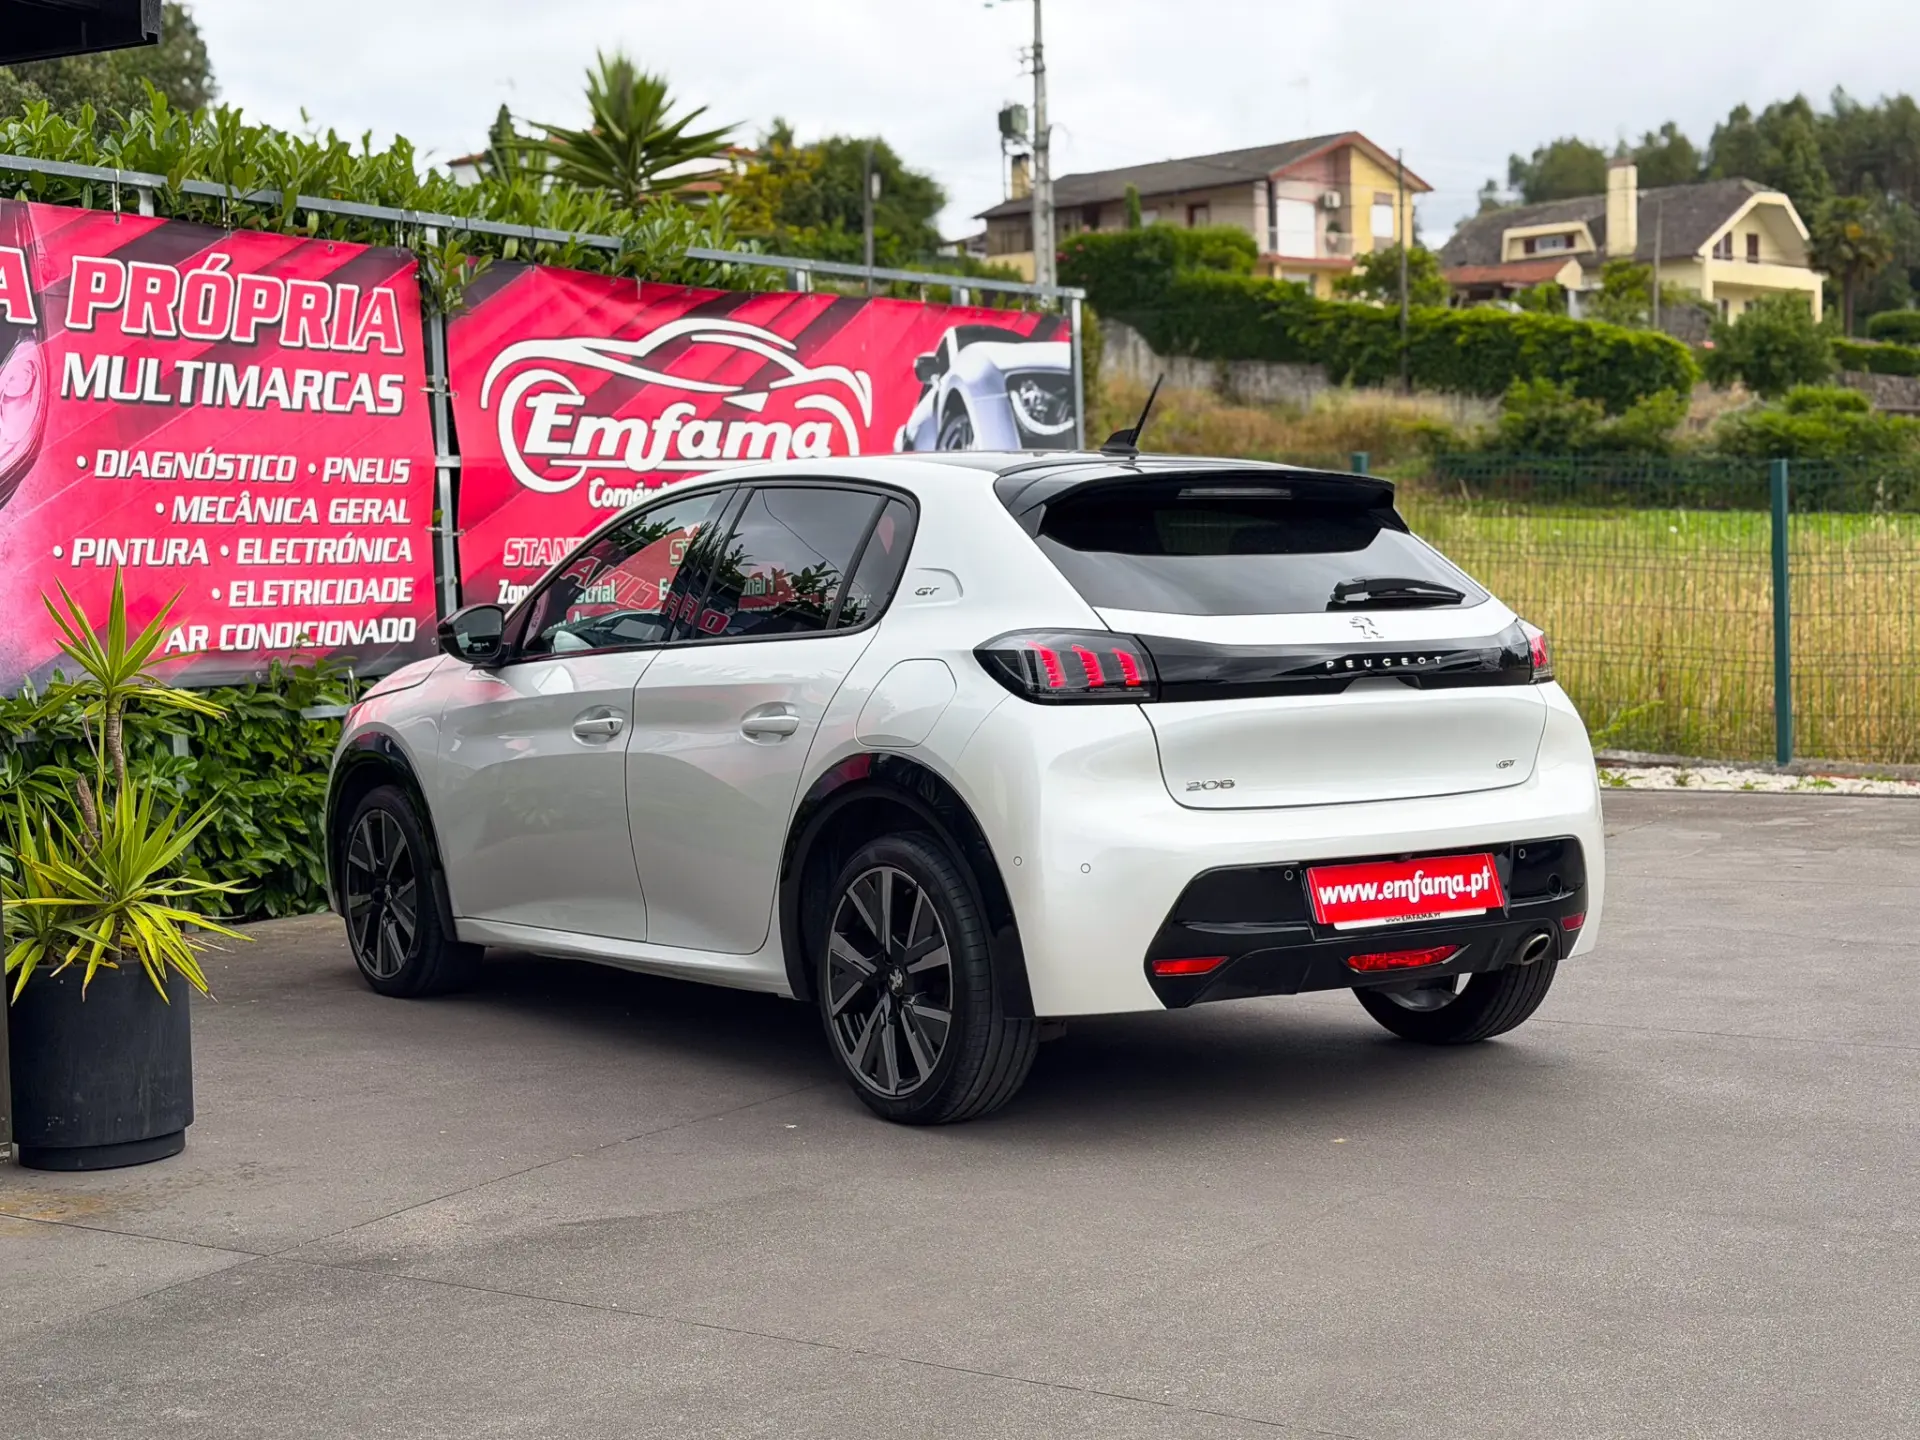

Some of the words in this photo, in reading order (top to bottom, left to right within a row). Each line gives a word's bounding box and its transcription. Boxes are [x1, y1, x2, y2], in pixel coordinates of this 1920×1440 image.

[65, 253, 404, 354] PRÓPRIA
[60, 352, 404, 414] MULTIMARCAS
[524, 391, 832, 471] Emfama
[95, 447, 297, 482] DIAGNÓSTICO
[322, 457, 411, 484] PNEUS
[172, 491, 319, 524] MECÂNICA
[328, 497, 411, 524] GERAL
[72, 538, 209, 566] PINTURA
[237, 532, 412, 564] ELECTRÓNICA
[229, 577, 413, 607] ELETRICIDADE
[915, 587, 940, 596] GT
[165, 626, 208, 654] AR
[220, 617, 416, 651] CONDICIONADO
[1326, 656, 1442, 669] PEUGEOT
[1185, 778, 1235, 792] 208
[1319, 865, 1490, 905] www.emfama.pt
